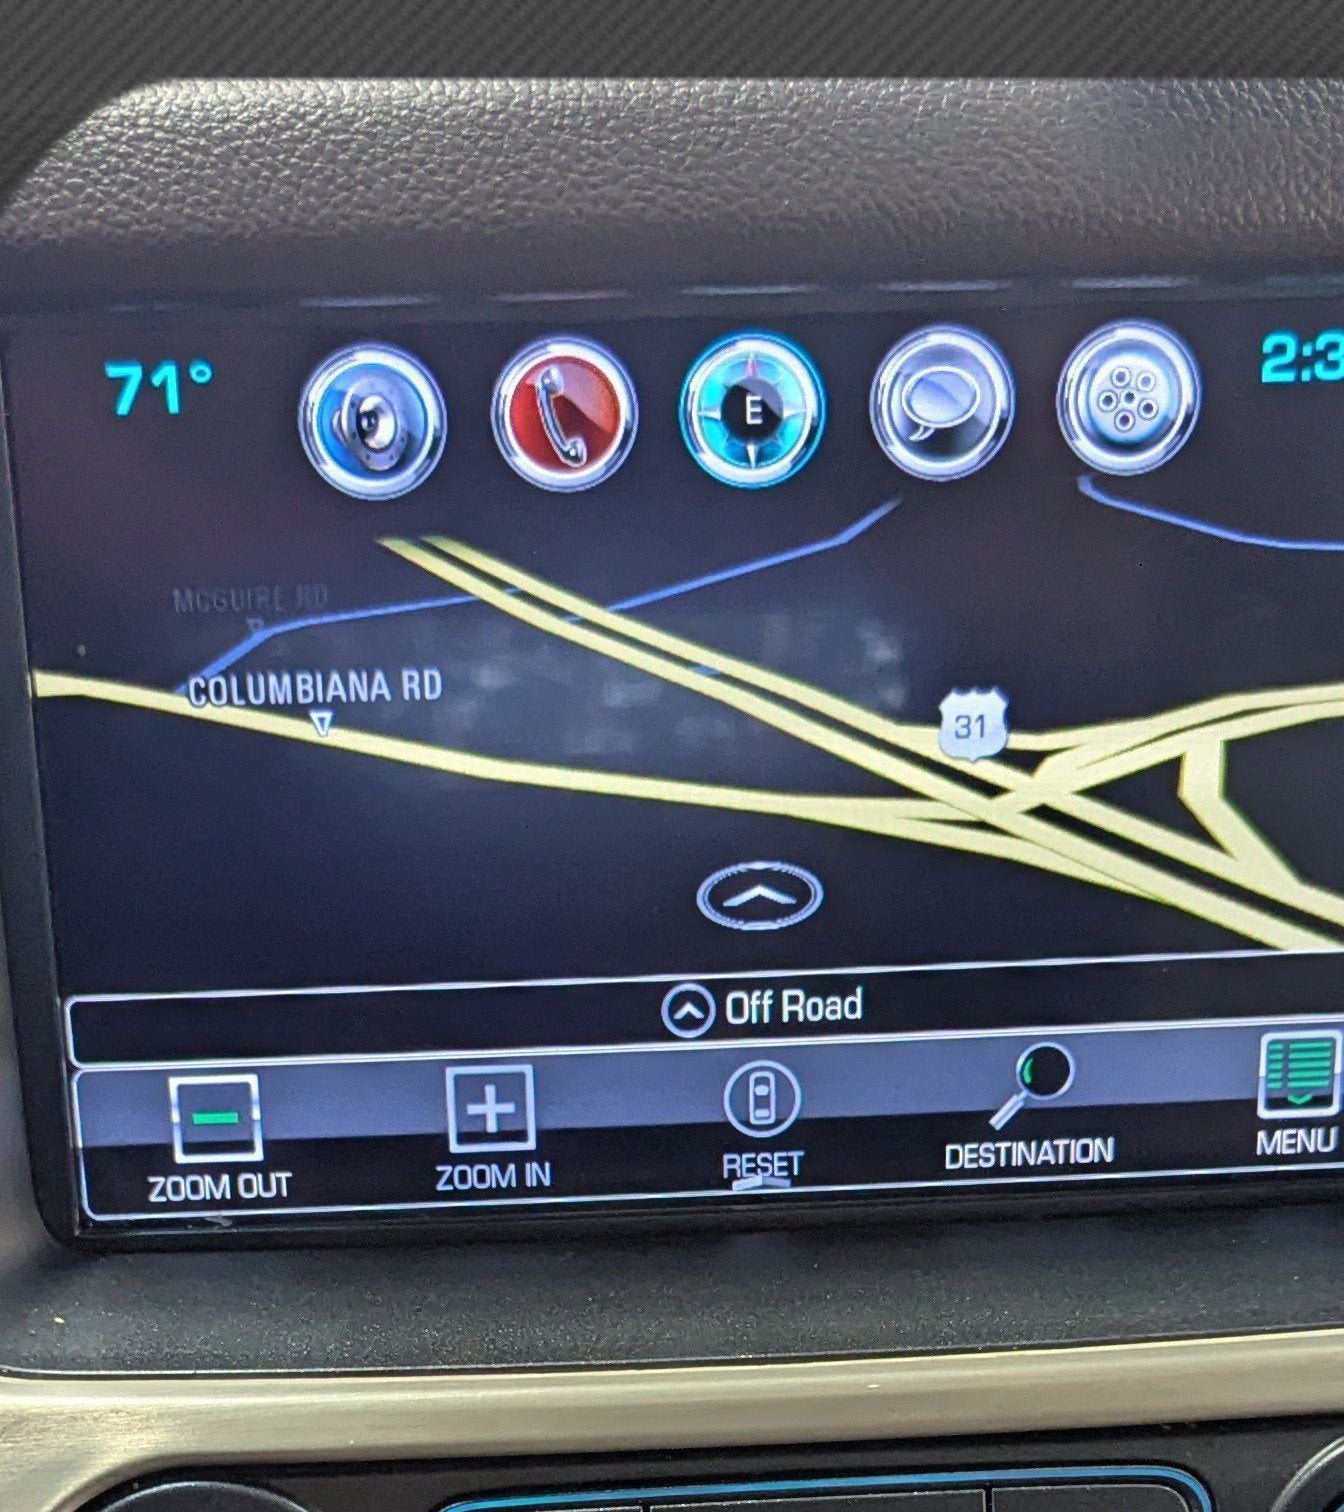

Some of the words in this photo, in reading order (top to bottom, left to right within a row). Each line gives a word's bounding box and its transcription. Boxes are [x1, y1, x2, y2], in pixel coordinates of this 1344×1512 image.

[745, 393, 763, 425] E
[188, 670, 391, 706] COLUMBIANA
[402, 669, 442, 700] RD
[956, 715, 984, 738] 31
[726, 990, 773, 1024] Off
[782, 986, 862, 1022] Road
[946, 1137, 1114, 1169] DESTINATION
[1257, 1127, 1338, 1155] MENU
[436, 1164, 516, 1190] ZOOM
[526, 1162, 550, 1187] IN
[723, 1151, 804, 1179] RESET
[148, 1174, 230, 1202] ZOOM
[238, 1172, 292, 1198] OUT
